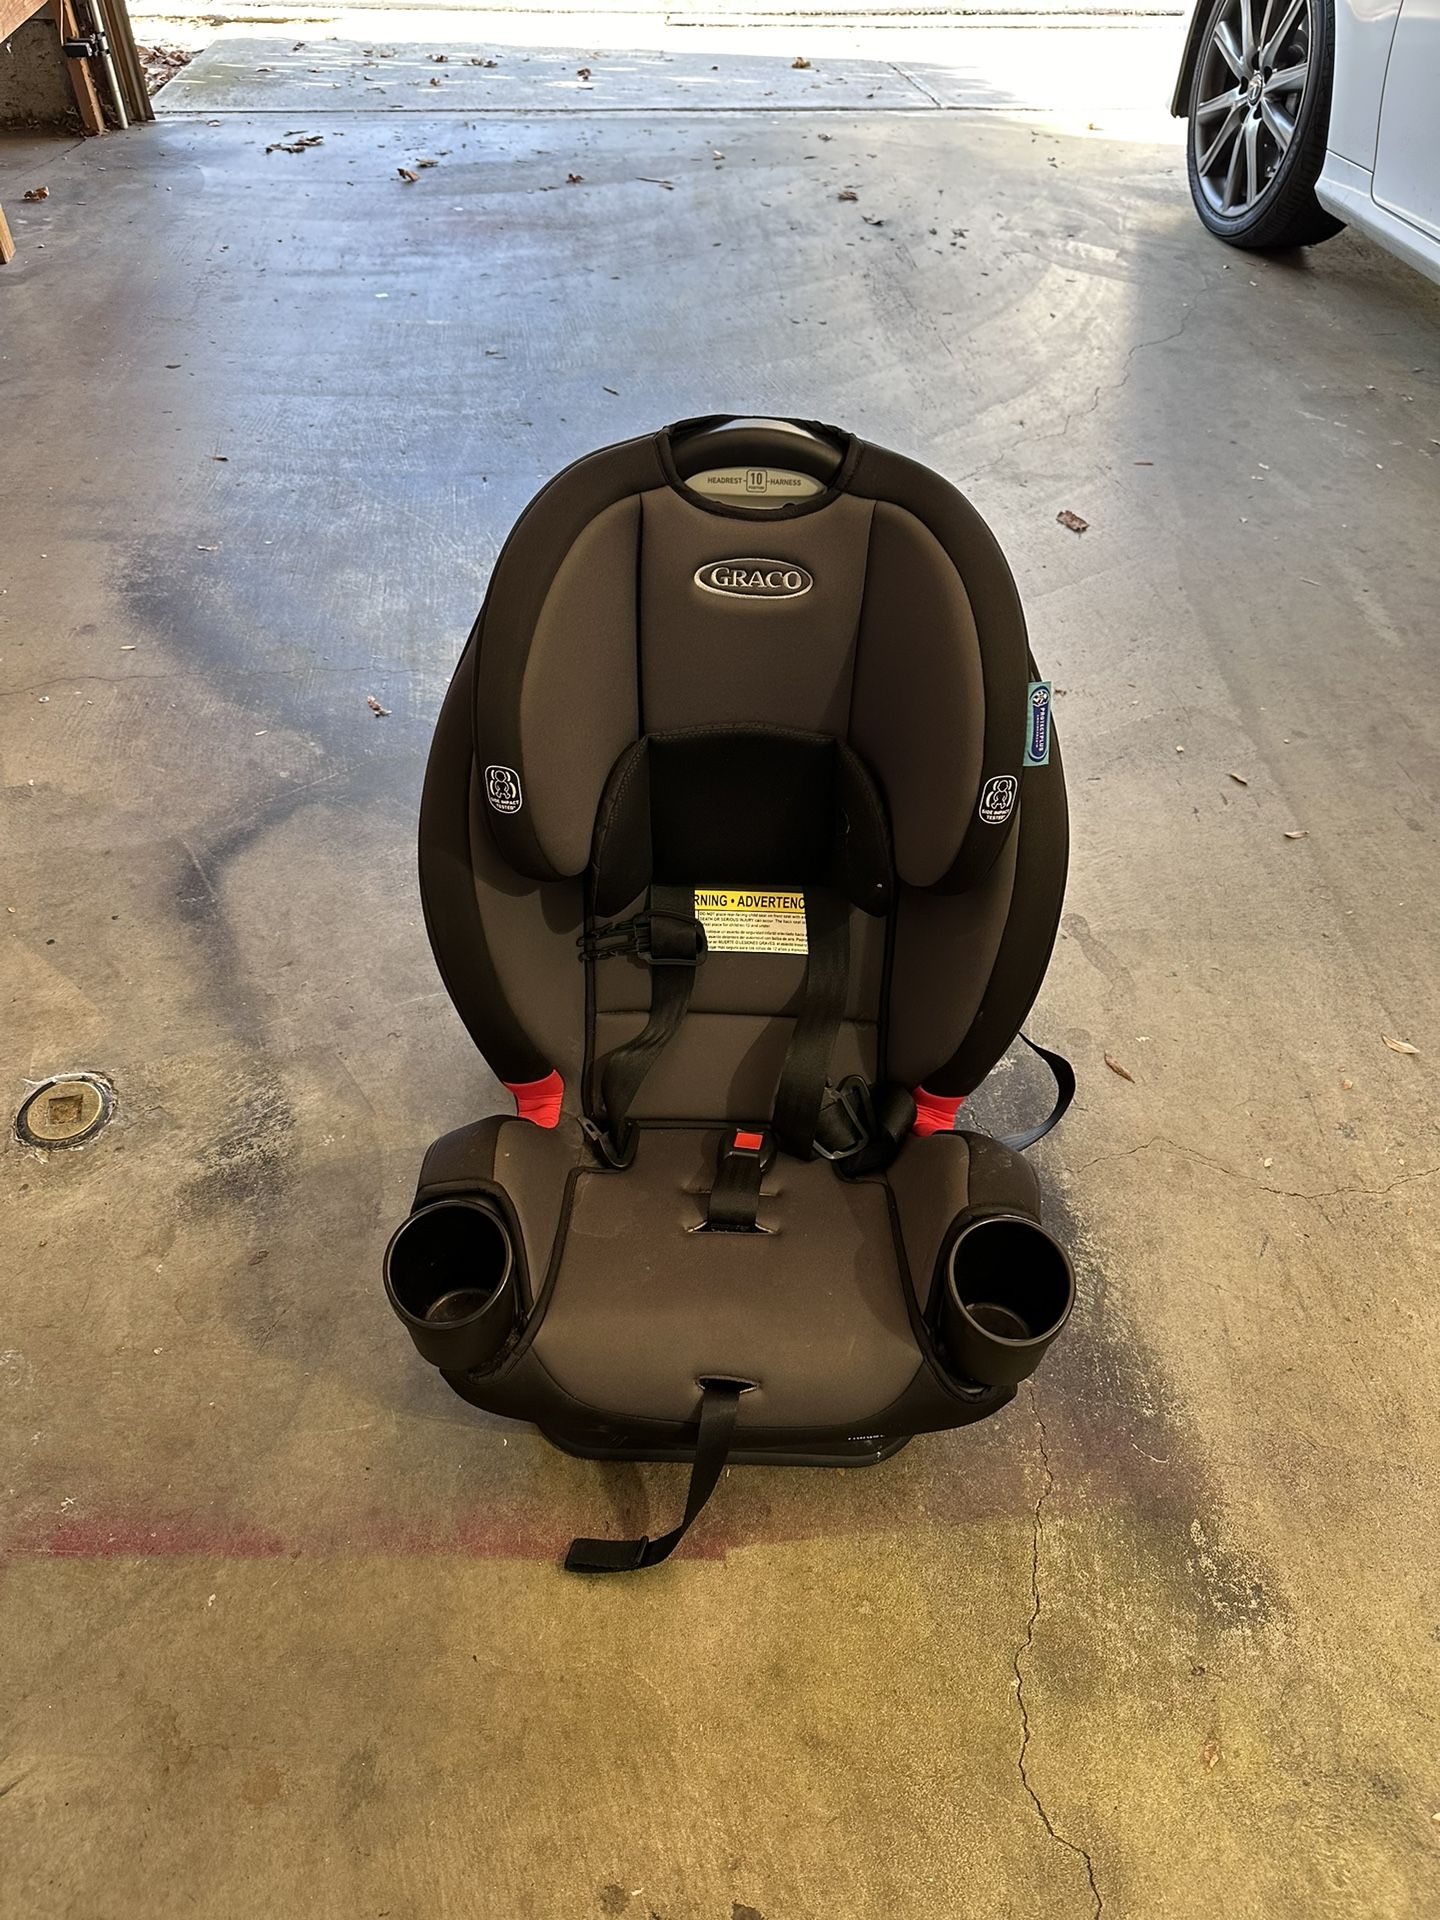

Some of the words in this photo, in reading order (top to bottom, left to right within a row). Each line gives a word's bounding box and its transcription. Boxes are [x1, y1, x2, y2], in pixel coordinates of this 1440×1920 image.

[750, 473, 763, 485] 10
[710, 567, 802, 590] GRACO
[694, 894, 727, 906] RNING
[737, 896, 805, 909] ADVERTENC
